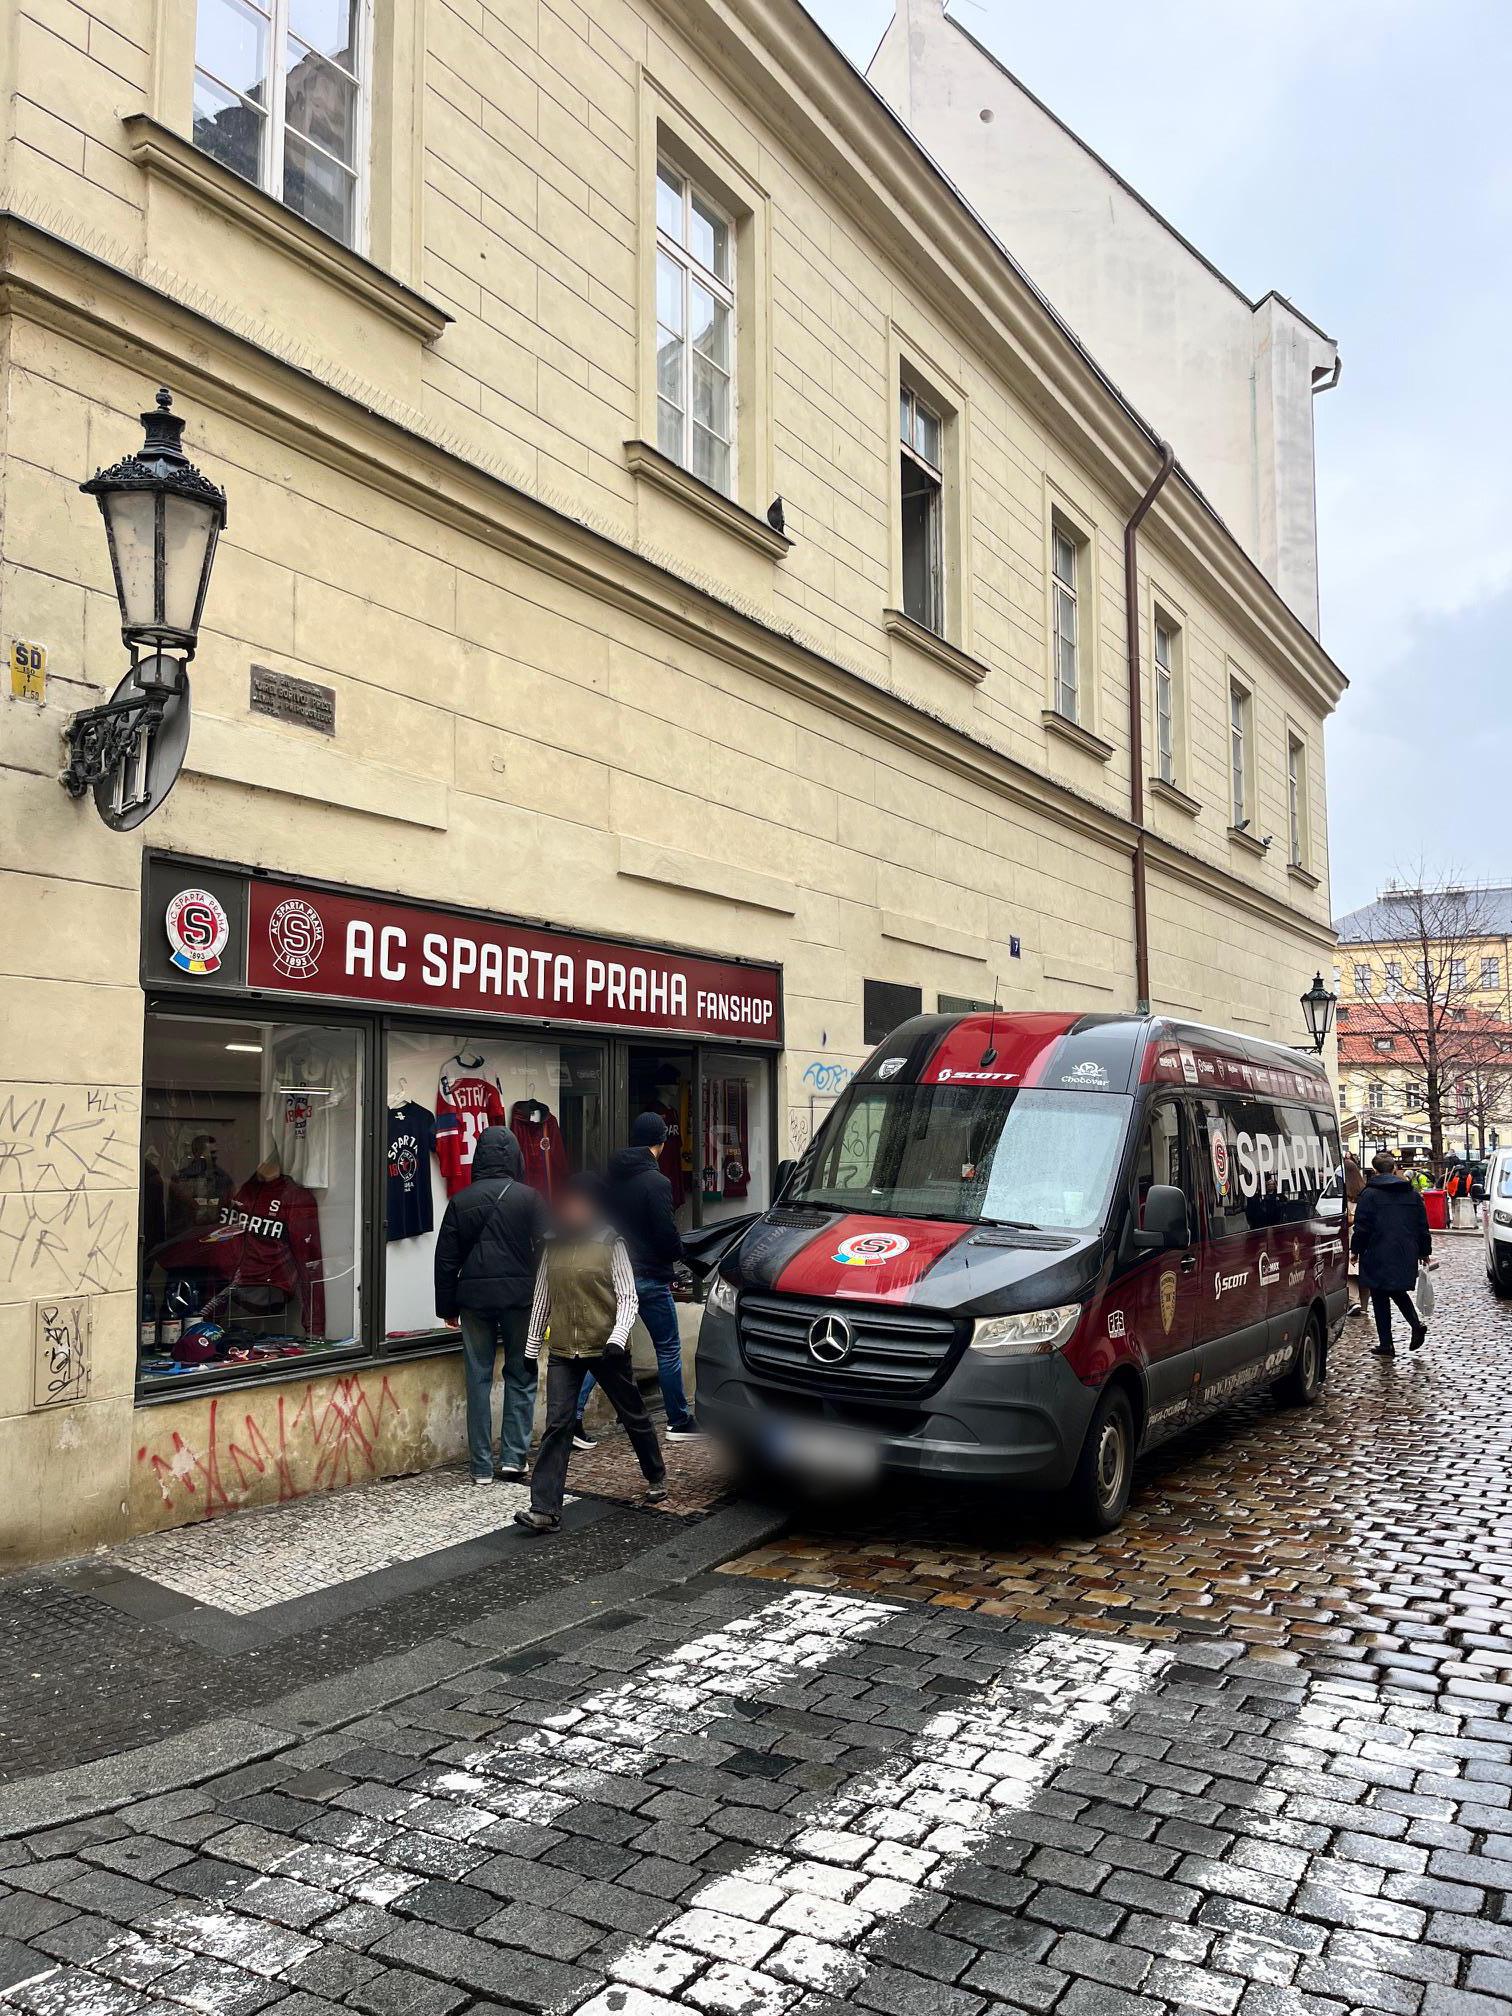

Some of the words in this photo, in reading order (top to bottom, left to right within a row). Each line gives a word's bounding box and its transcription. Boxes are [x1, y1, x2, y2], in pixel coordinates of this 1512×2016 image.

[176, 893, 204, 909] SPARTA
[208, 900, 226, 932] PRAHA
[271, 918, 279, 935] AC
[276, 901, 304, 918] SPARTA
[306, 908, 323, 941] PRAHA
[283, 913, 310, 954] S
[285, 954, 308, 967] 1893
[345, 920, 407, 982] AC
[422, 933, 574, 1003] SPARTA
[585, 959, 687, 1017] PRAHA
[697, 990, 774, 1026] FANSHOP
[950, 1071, 1020, 1082] SCOTT
[1236, 1131, 1338, 1198] SPARTA
[219, 1206, 284, 1239] SPARTA
[269, 1199, 281, 1212] S
[1221, 1271, 1249, 1291] SCOTT
